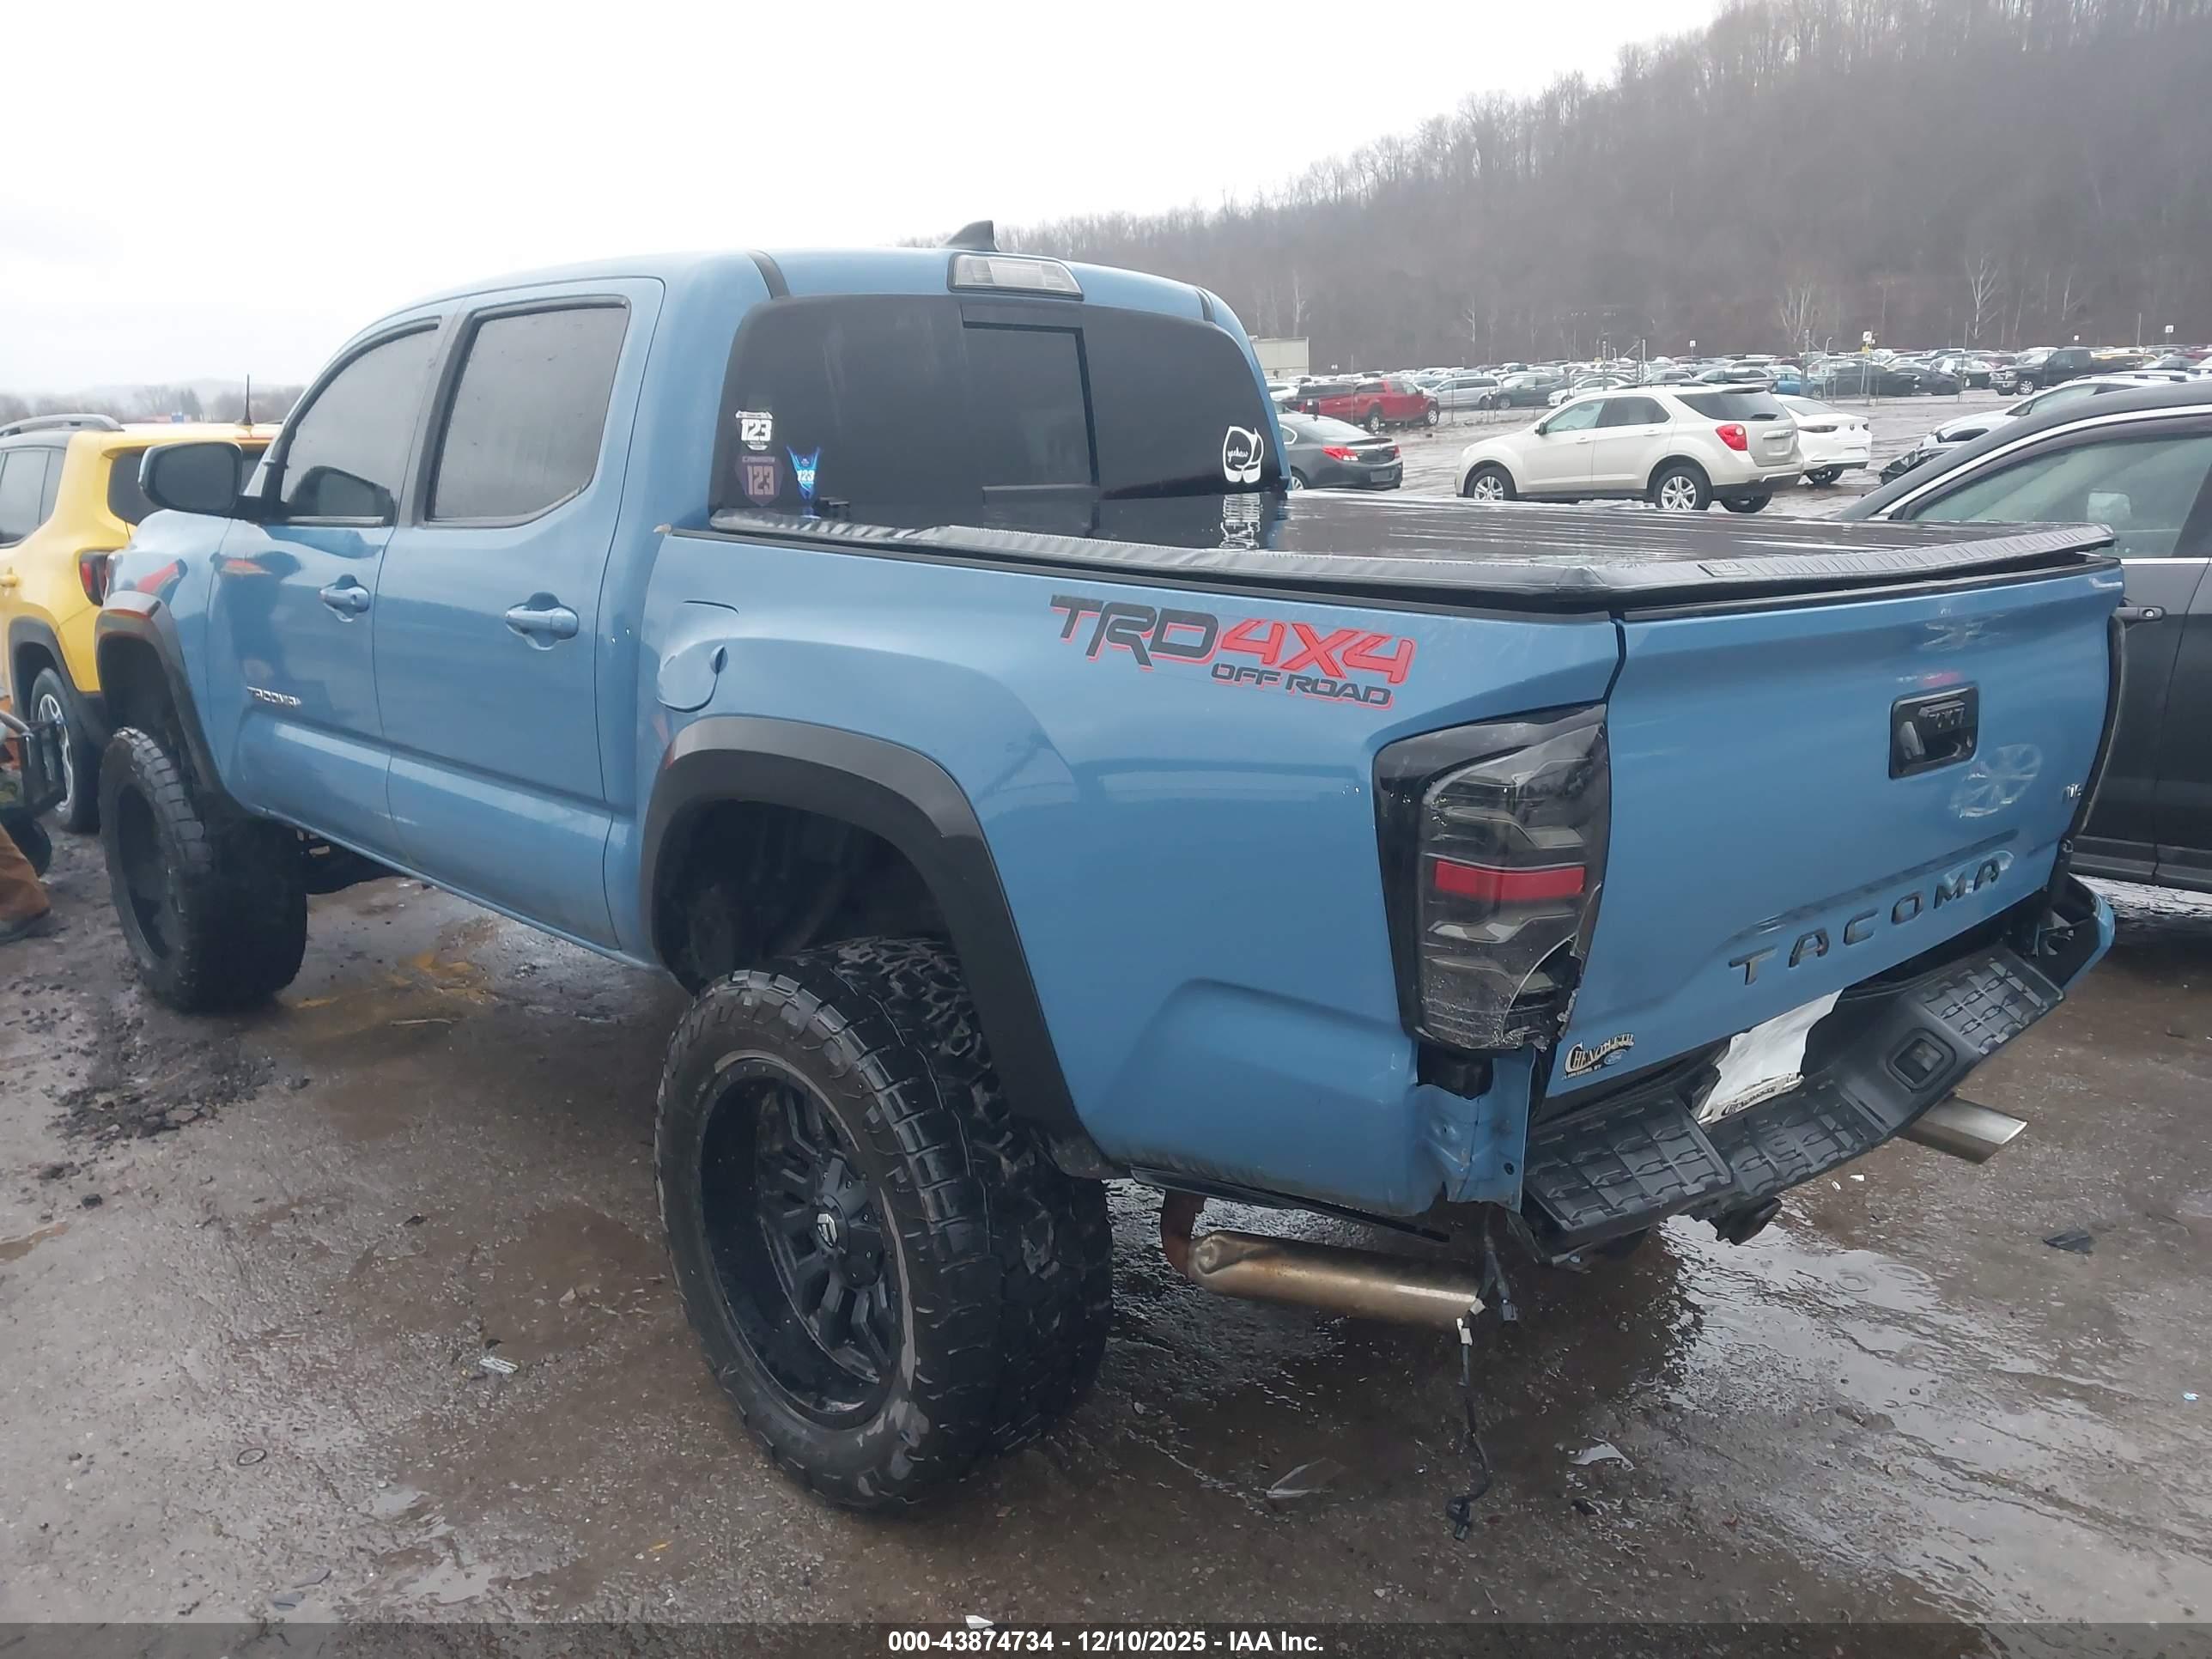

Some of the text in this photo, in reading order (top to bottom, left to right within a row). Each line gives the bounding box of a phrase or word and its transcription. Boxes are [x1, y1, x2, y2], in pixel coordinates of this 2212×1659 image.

[741, 419, 772, 441] 123
[747, 465, 775, 495] 123
[797, 470, 816, 482] 123
[1049, 594, 1416, 685] TRD 4X4
[1211, 662, 1395, 709] OFF ROAD
[1728, 857, 2002, 986] TACOMA
